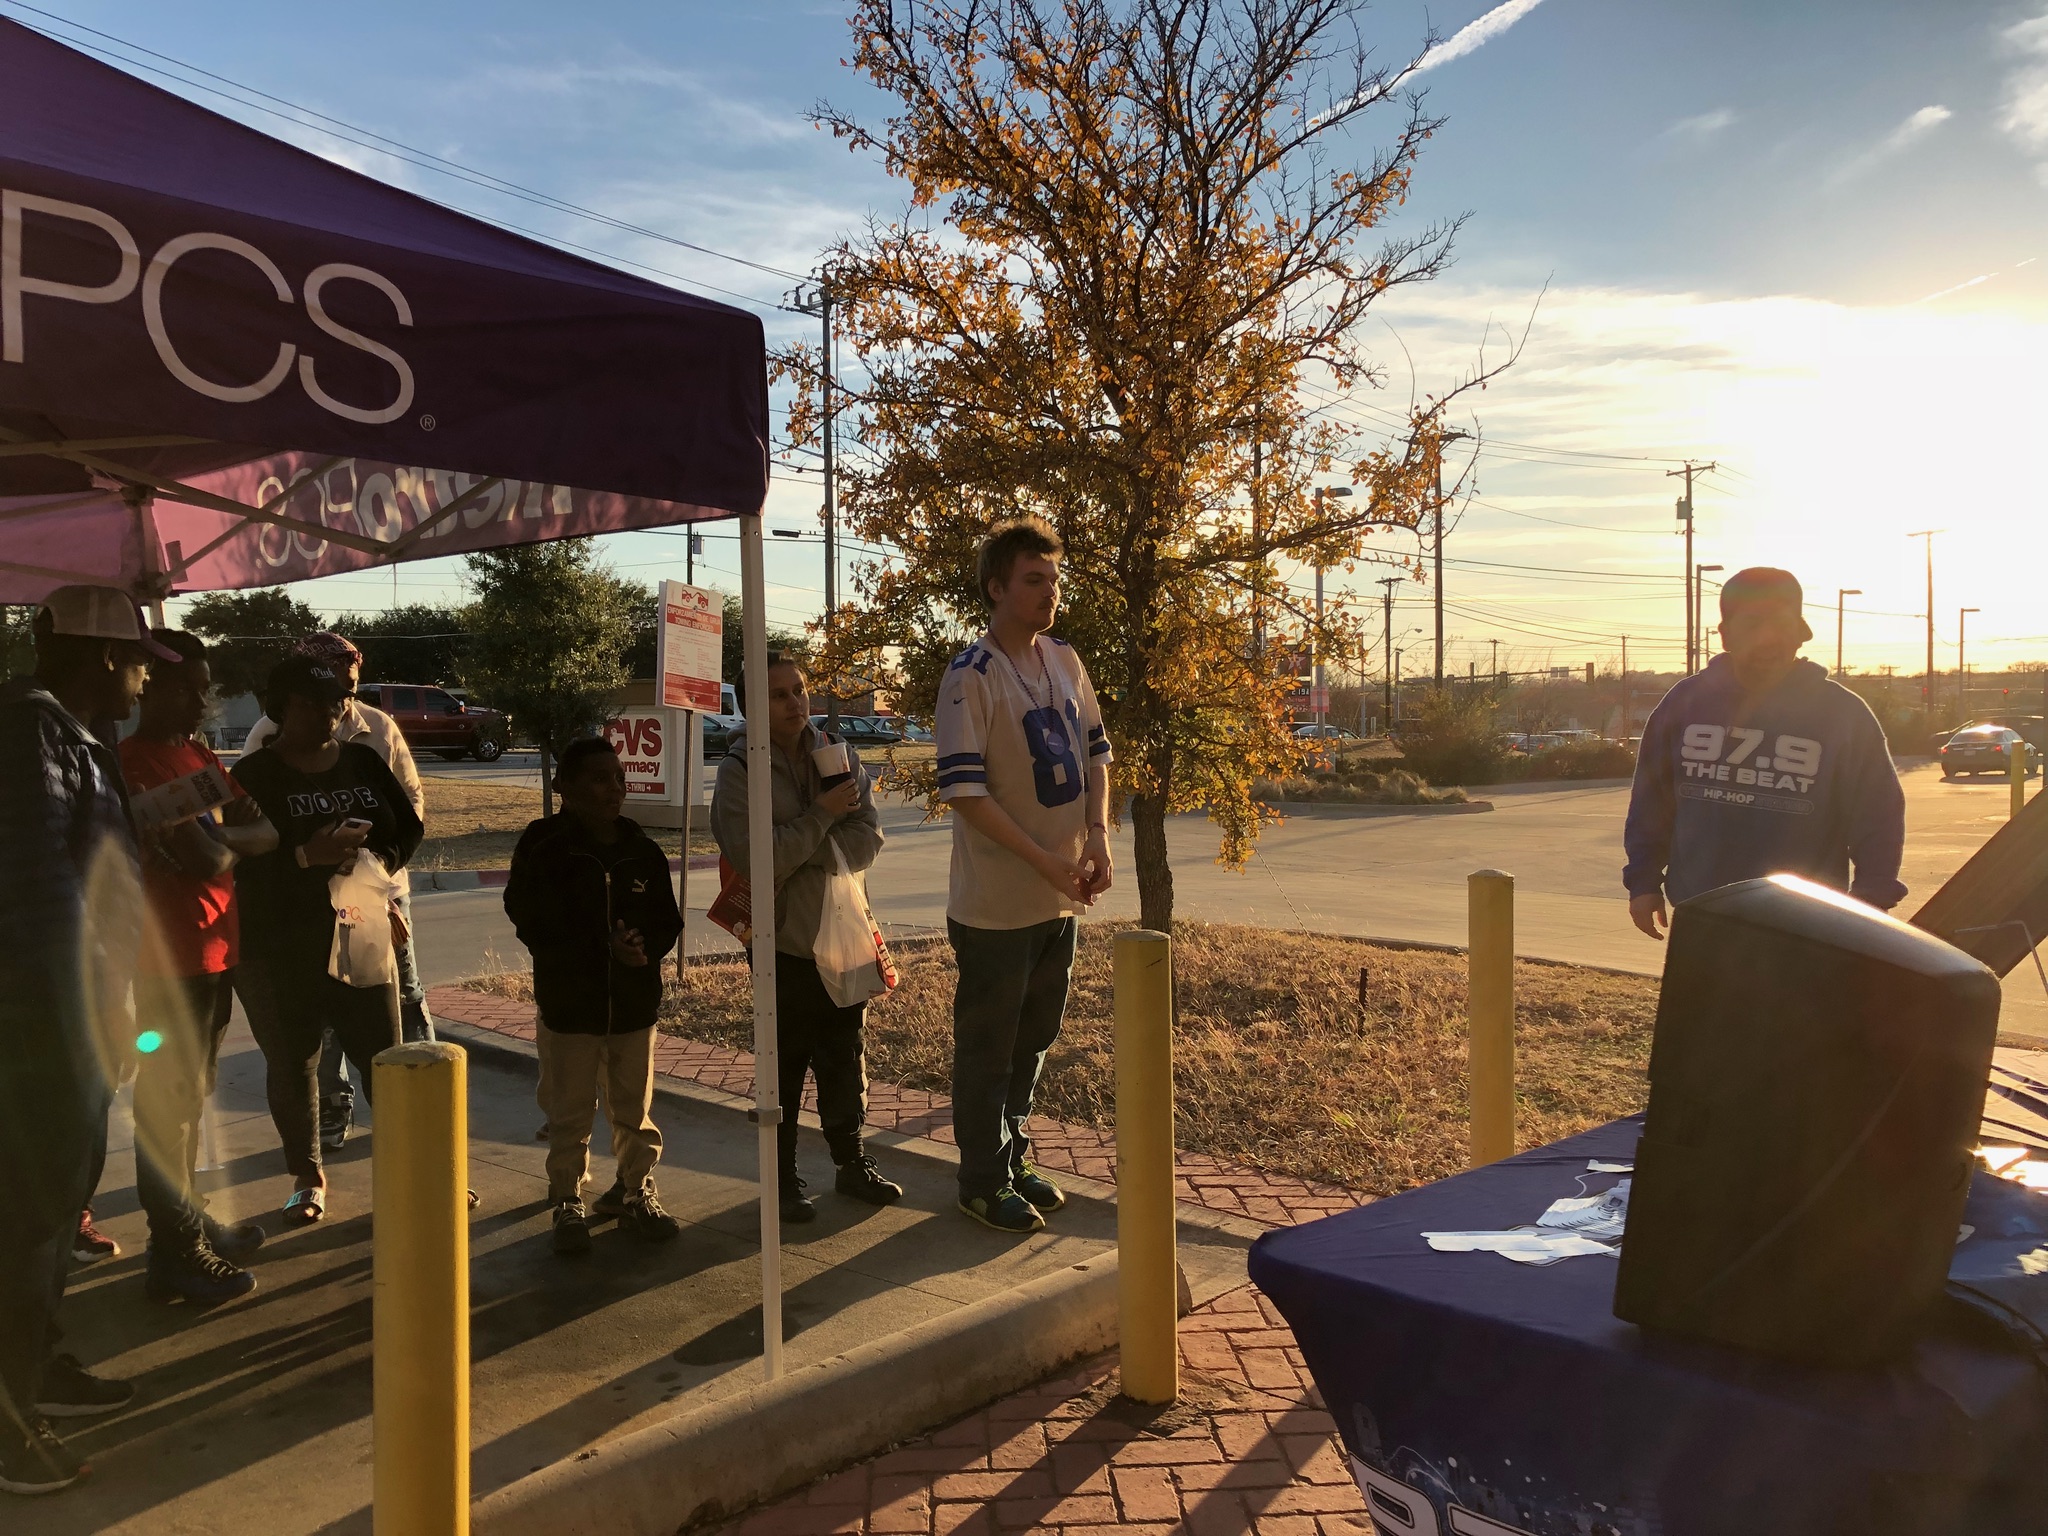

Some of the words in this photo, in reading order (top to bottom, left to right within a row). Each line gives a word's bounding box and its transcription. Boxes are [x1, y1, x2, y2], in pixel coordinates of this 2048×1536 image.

[603, 718, 663, 757] CVS
[1681, 724, 1822, 776] 97.9
[1681, 761, 1731, 781] THE
[1736, 768, 1815, 793] BEAT
[287, 786, 378, 817] NOPE
[1703, 788, 1755, 804] HIP-HOP
